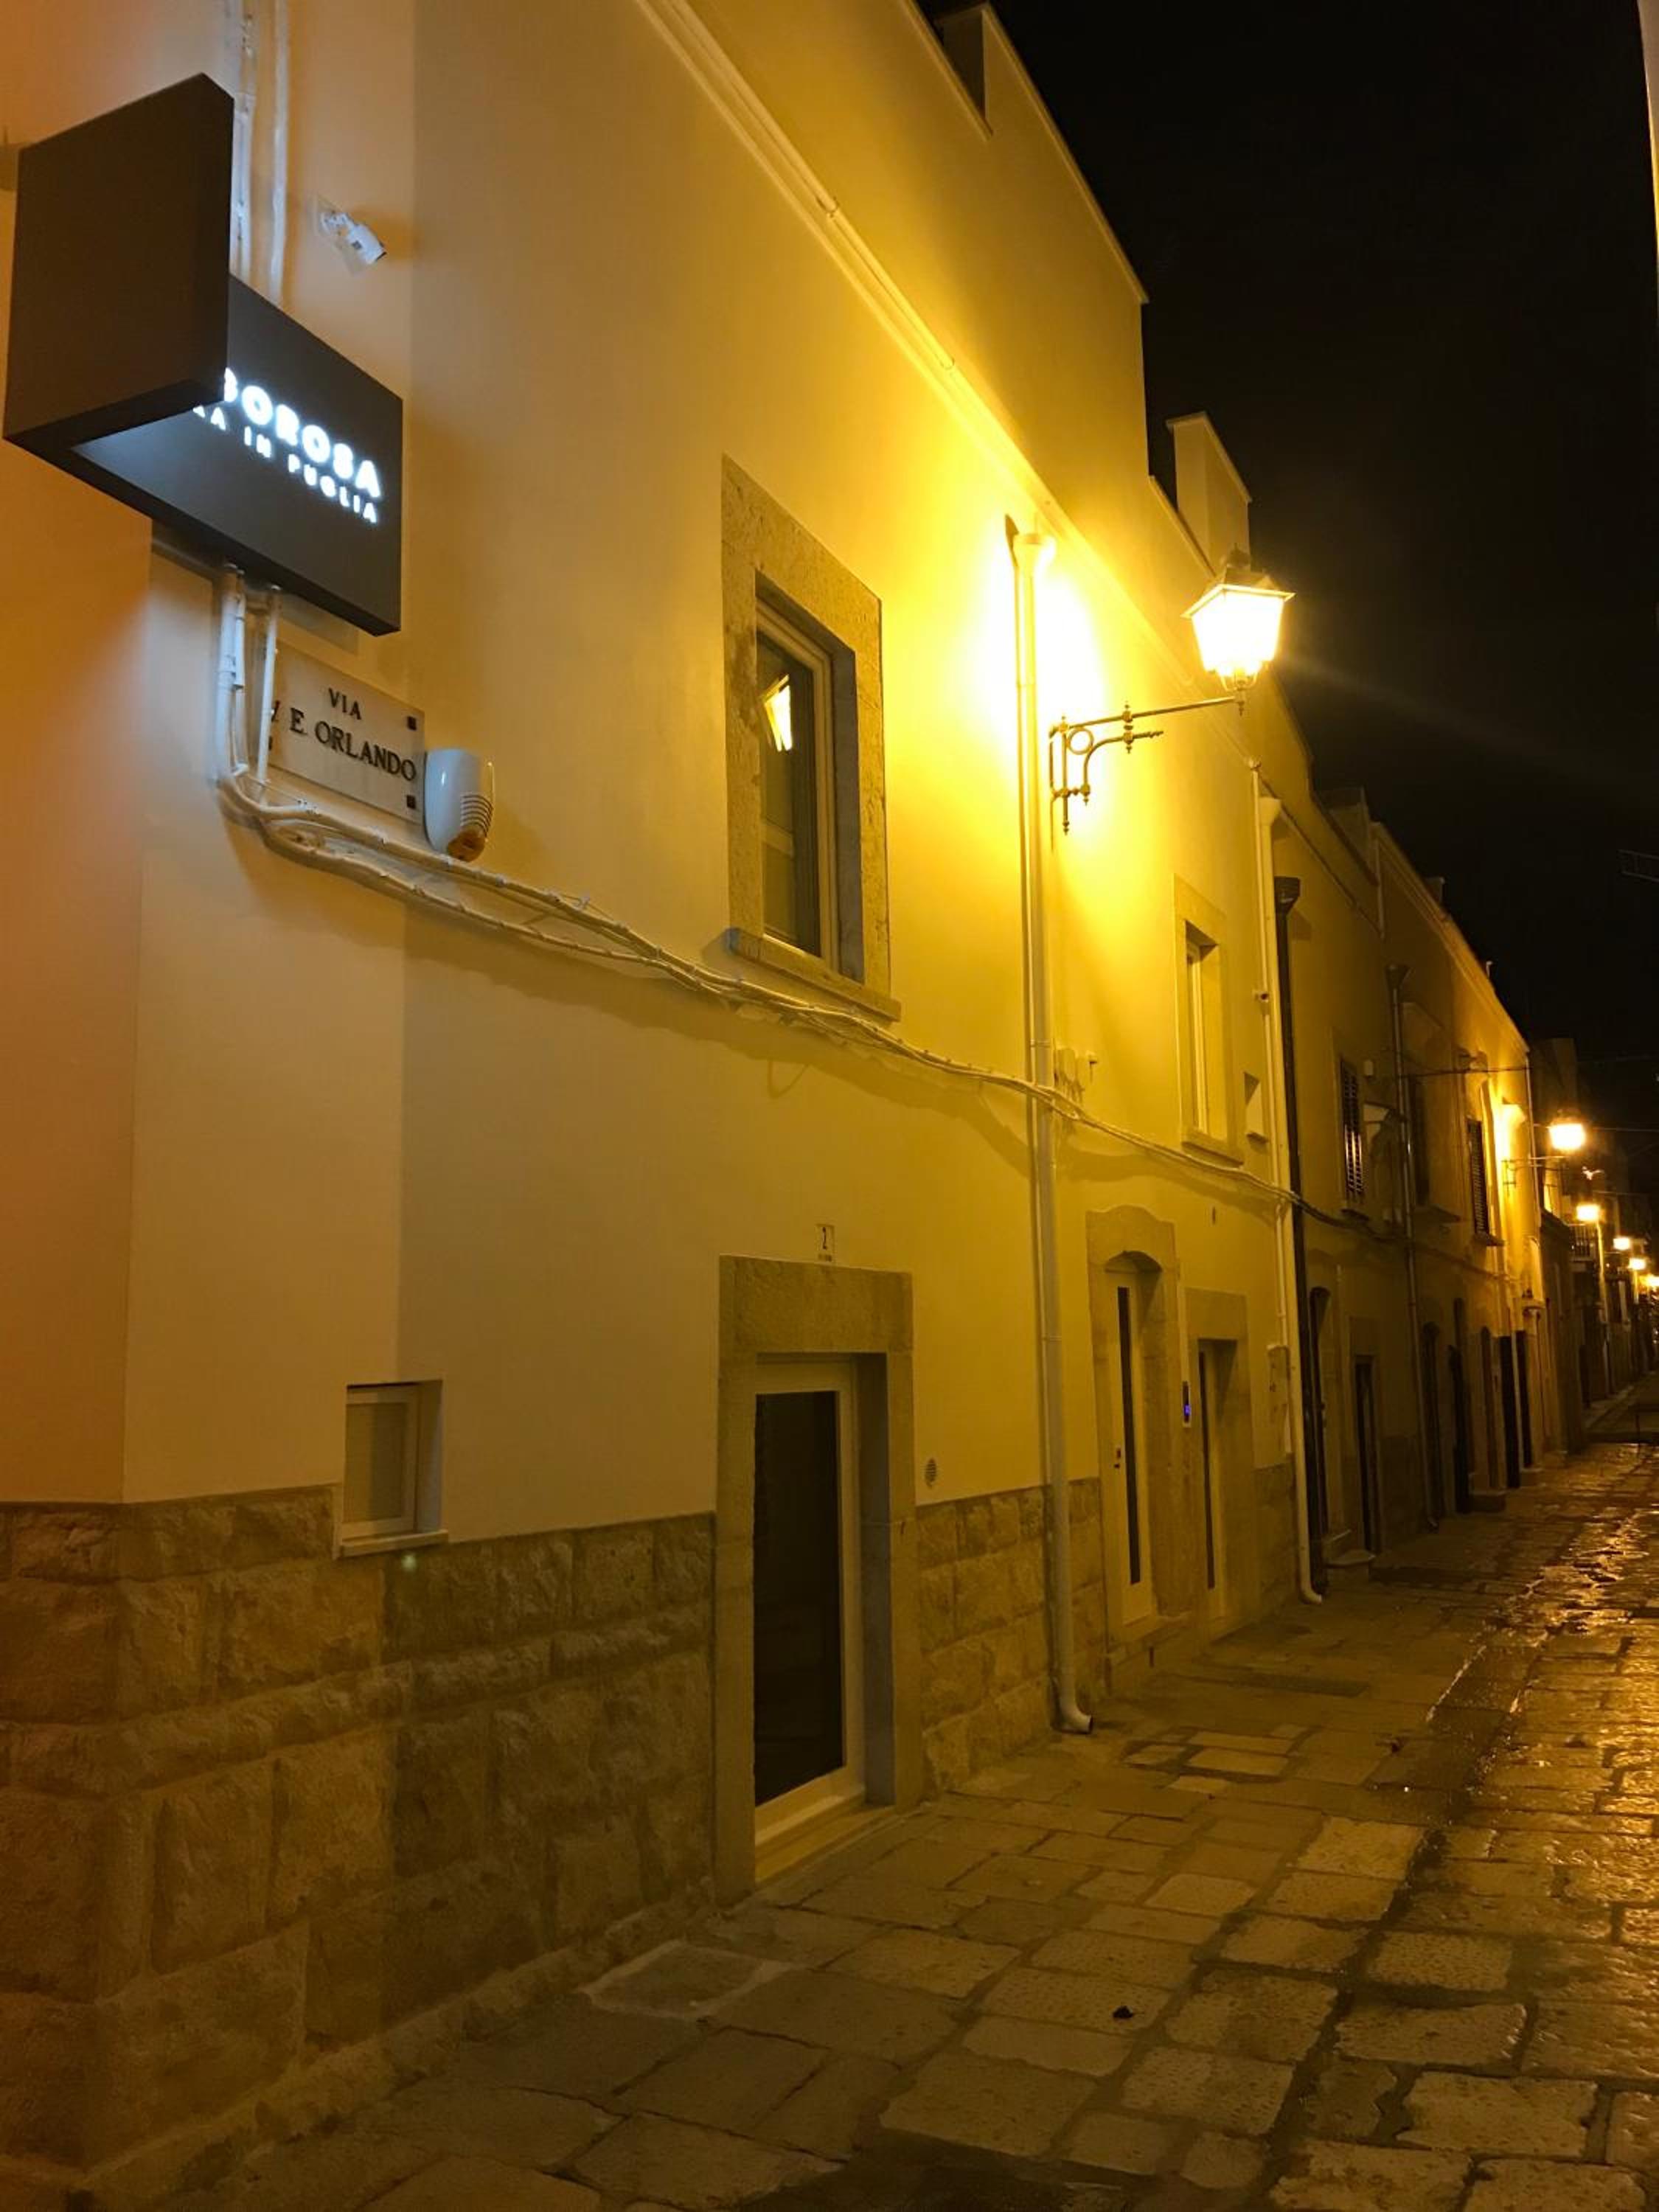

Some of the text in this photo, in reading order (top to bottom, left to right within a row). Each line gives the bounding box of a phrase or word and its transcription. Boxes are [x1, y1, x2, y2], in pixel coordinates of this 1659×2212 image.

[244, 425, 271, 459] IN
[288, 453, 378, 524] PUGLIA
[328, 687, 362, 720] VIA
[315, 720, 417, 782] ORLANDO
